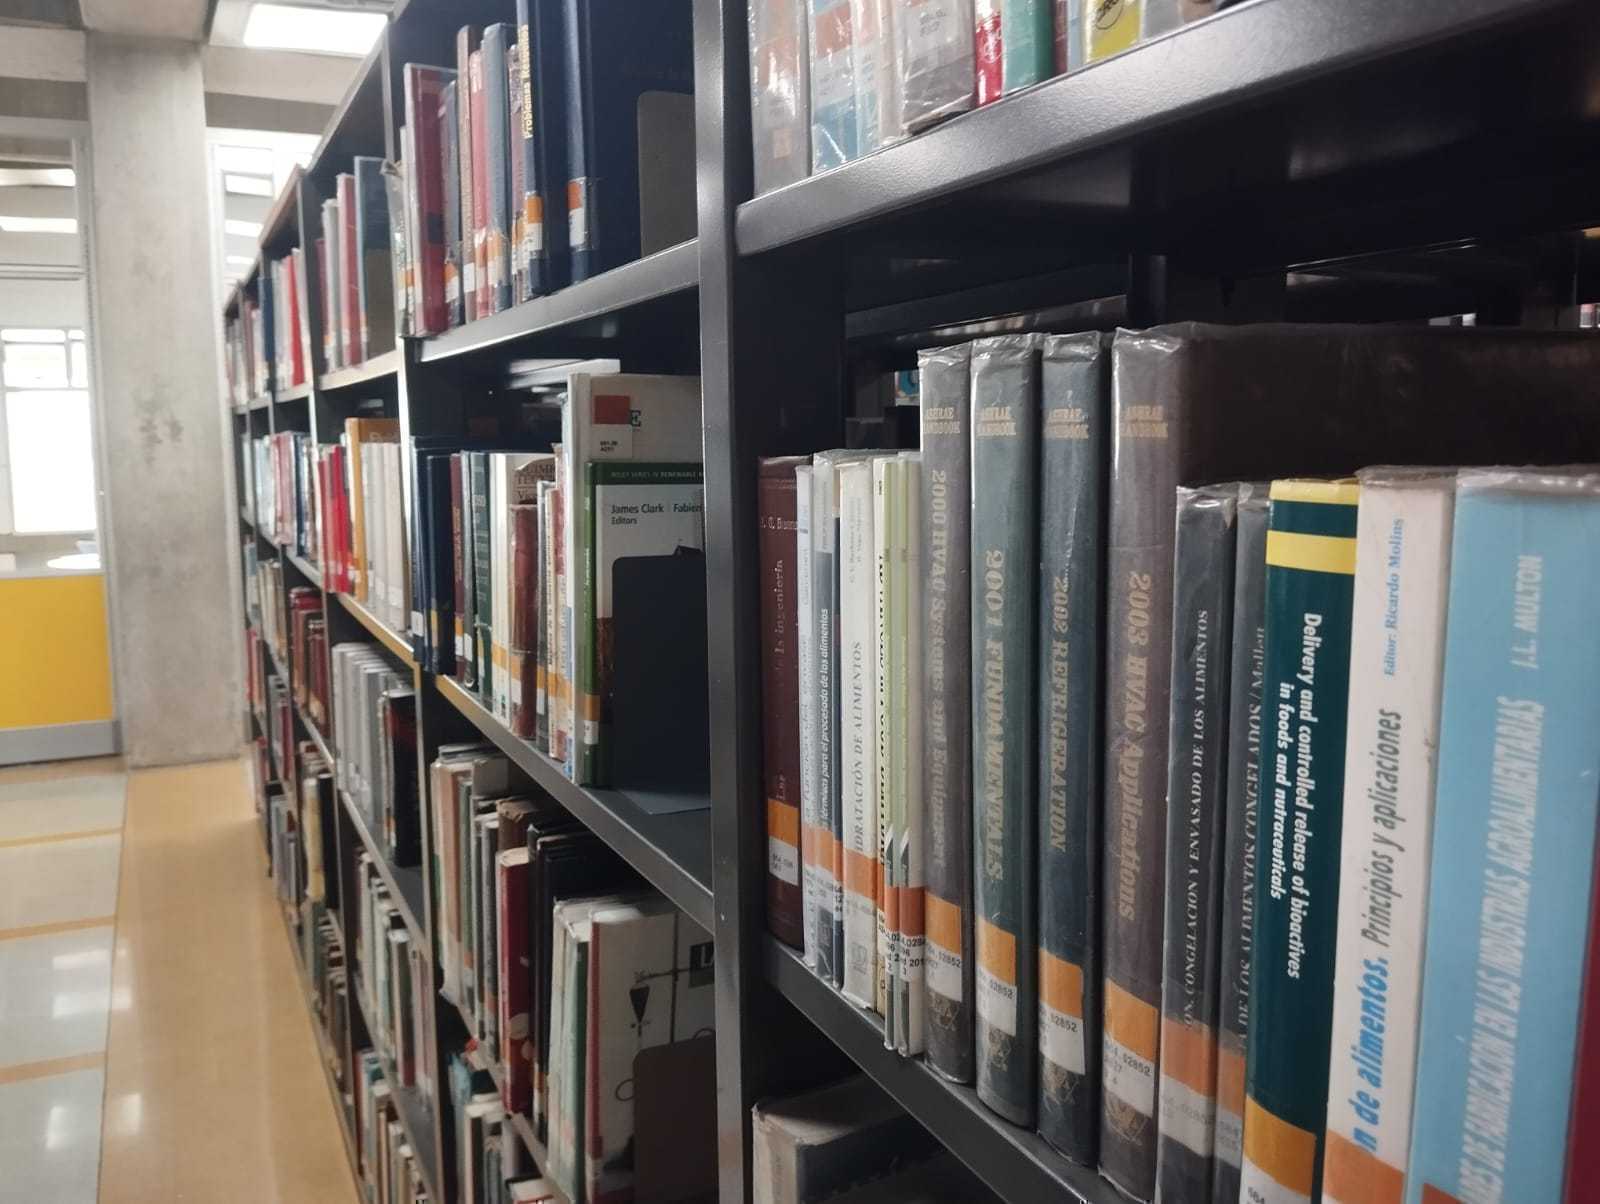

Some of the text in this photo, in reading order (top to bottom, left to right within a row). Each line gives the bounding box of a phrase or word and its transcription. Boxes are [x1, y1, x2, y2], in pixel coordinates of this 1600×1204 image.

[611, 503, 639, 514] James
[641, 503, 664, 513] Clark
[611, 516, 638, 525] Editors
[931, 469, 947, 525] 2000
[930, 530, 947, 592] HVAC
[1384, 519, 1405, 677] Editor: Ricardo Molins
[1513, 554, 1543, 634] MULTON
[819, 608, 829, 658] alimentos
[929, 596, 947, 691] Systems
[1195, 610, 1208, 705] ALIMENTOS
[820, 660, 829, 674] los
[820, 676, 829, 688] de
[852, 640, 863, 731] ALIMENTOS
[820, 689, 830, 742] procesado
[852, 736, 864, 755] DE
[984, 550, 1005, 881] 2001 FUNDAMENTALS
[1050, 576, 1069, 853] 2002 REFRIGERATION
[1118, 570, 1152, 921] 2003 HVAC Applications
[1193, 709, 1206, 739] LOS
[820, 753, 830, 778] para
[1191, 745, 1204, 767] DE
[1368, 708, 1407, 831] aplicaciones
[1188, 772, 1202, 861] ENVASADO
[1270, 682, 1296, 900] in foods and nutraceuticals
[1288, 612, 1323, 980] Delivery and controlled release of bioactives
[1188, 868, 1199, 877] Y
[1372, 831, 1406, 852] y
[1360, 850, 1403, 948] Principios
[1350, 956, 1391, 1089] alimentos.
[1347, 1090, 1381, 1126] de
